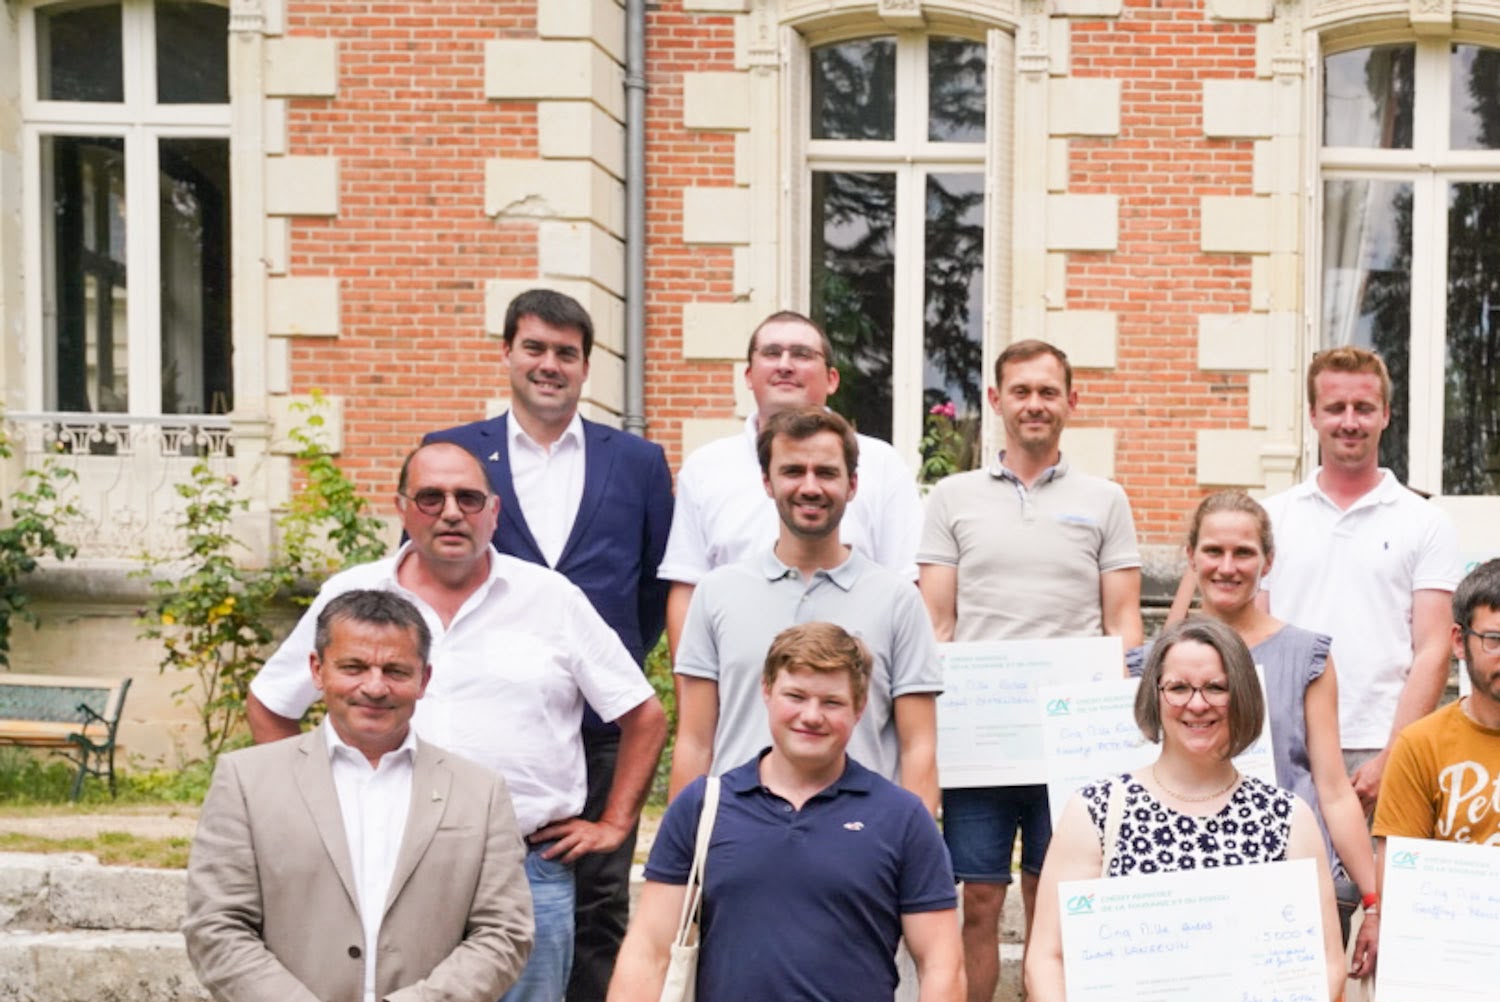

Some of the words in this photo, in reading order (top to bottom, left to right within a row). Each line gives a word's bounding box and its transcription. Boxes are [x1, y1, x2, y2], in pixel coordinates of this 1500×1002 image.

[1047, 697, 1071, 716] CA
[1391, 850, 1421, 869] CA
[1067, 893, 1095, 915] CA
[1281, 903, 1296, 923] €
